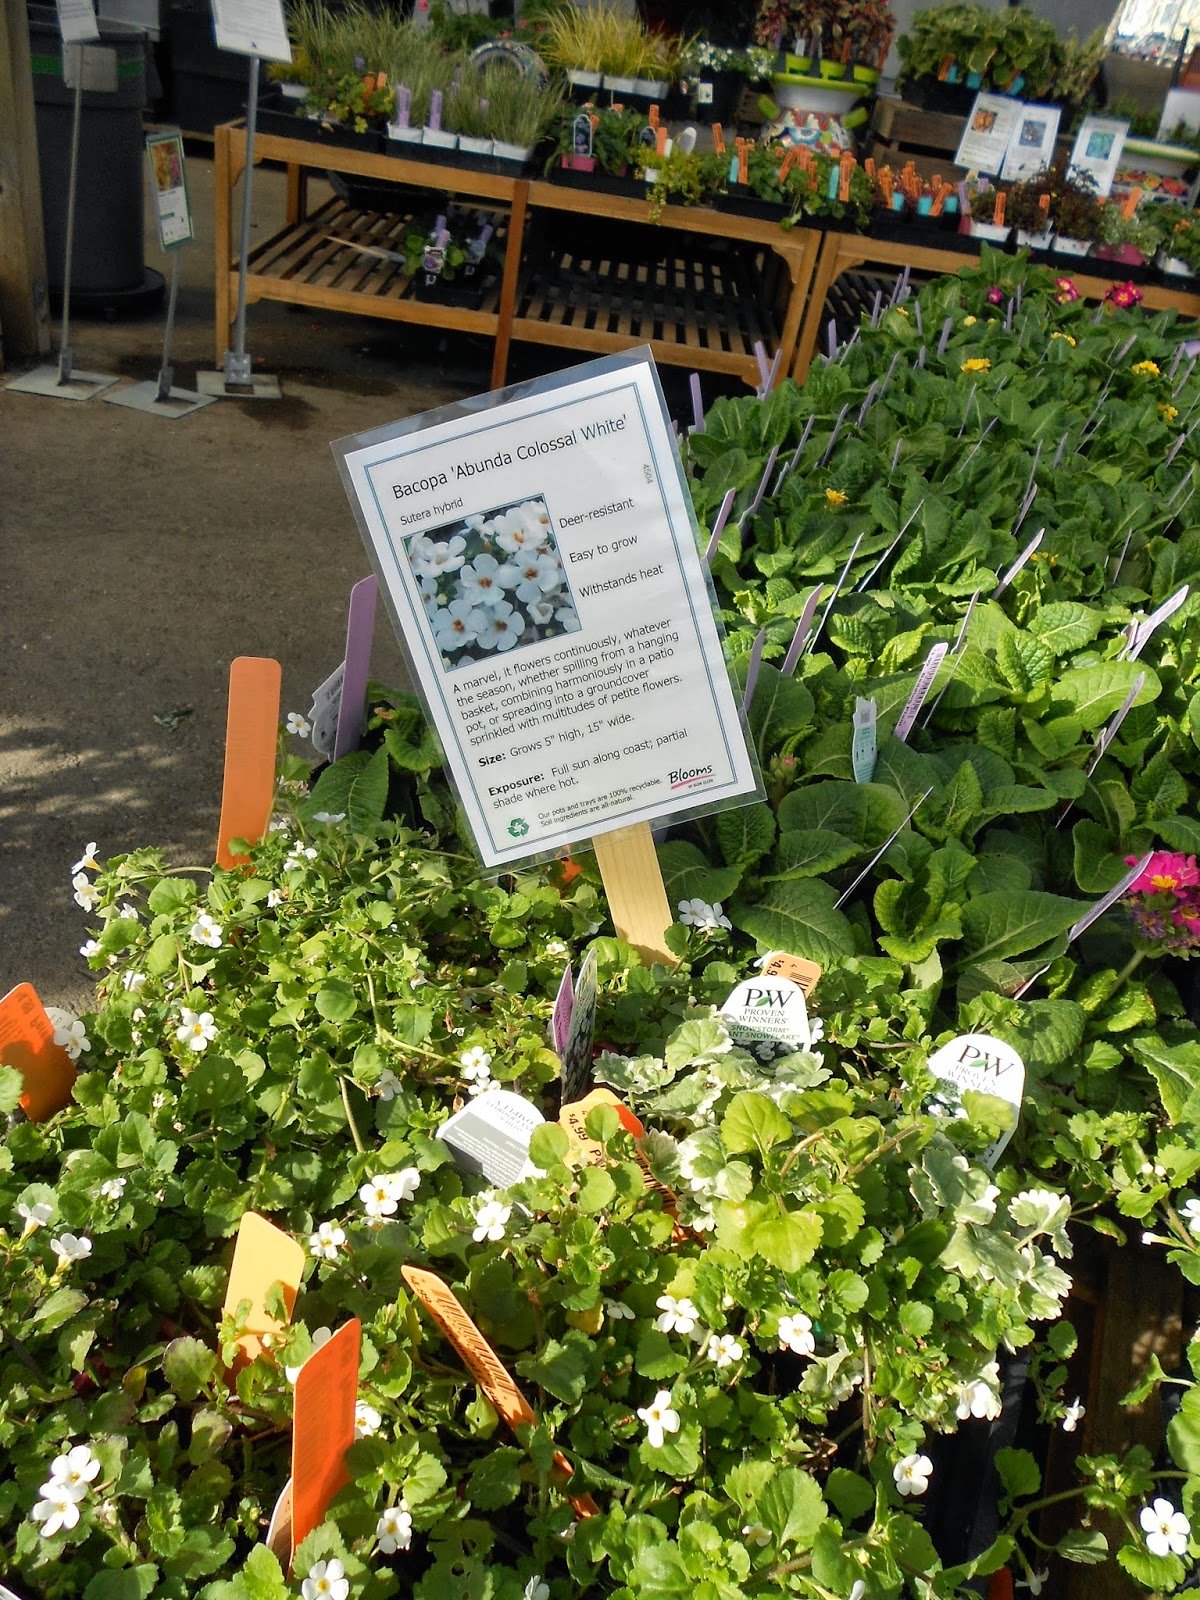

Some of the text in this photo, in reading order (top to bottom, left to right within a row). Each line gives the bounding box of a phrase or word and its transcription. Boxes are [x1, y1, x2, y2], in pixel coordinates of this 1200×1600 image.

[391, 413, 627, 500] Bacopa 'Abunda Colossal White'
[399, 496, 464, 526] Sutera hybrid
[558, 496, 635, 529] Deer-resistant
[568, 534, 638, 564] Easy to grow
[578, 563, 664, 598] Withstands heat
[452, 618, 671, 694] A marvel, it flowers continuously, whatever
[455, 631, 679, 707] the season, whether spilling from a hanging
[459, 647, 674, 721] basket, combining harmoniously in a patio
[464, 668, 649, 735] pot, or spreading into a groundcover
[469, 674, 683, 746] sprinkled with multitudes of petite flowers.
[477, 712, 635, 768] Size: Grows 5" high, 15" wide.
[487, 727, 688, 796] Exposure: Full sun along coast; partial
[666, 764, 713, 784] Blooms
[492, 775, 579, 809] shade where hot.
[537, 778, 663, 820] Our pots and trays are 100% recyclable.
[539, 793, 635, 828] Soil ingredients are all-natural.
[766, 959, 785, 976] $4.9
[743, 1008, 786, 1017] PROVEN
[569, 1113, 589, 1141] $4.99
